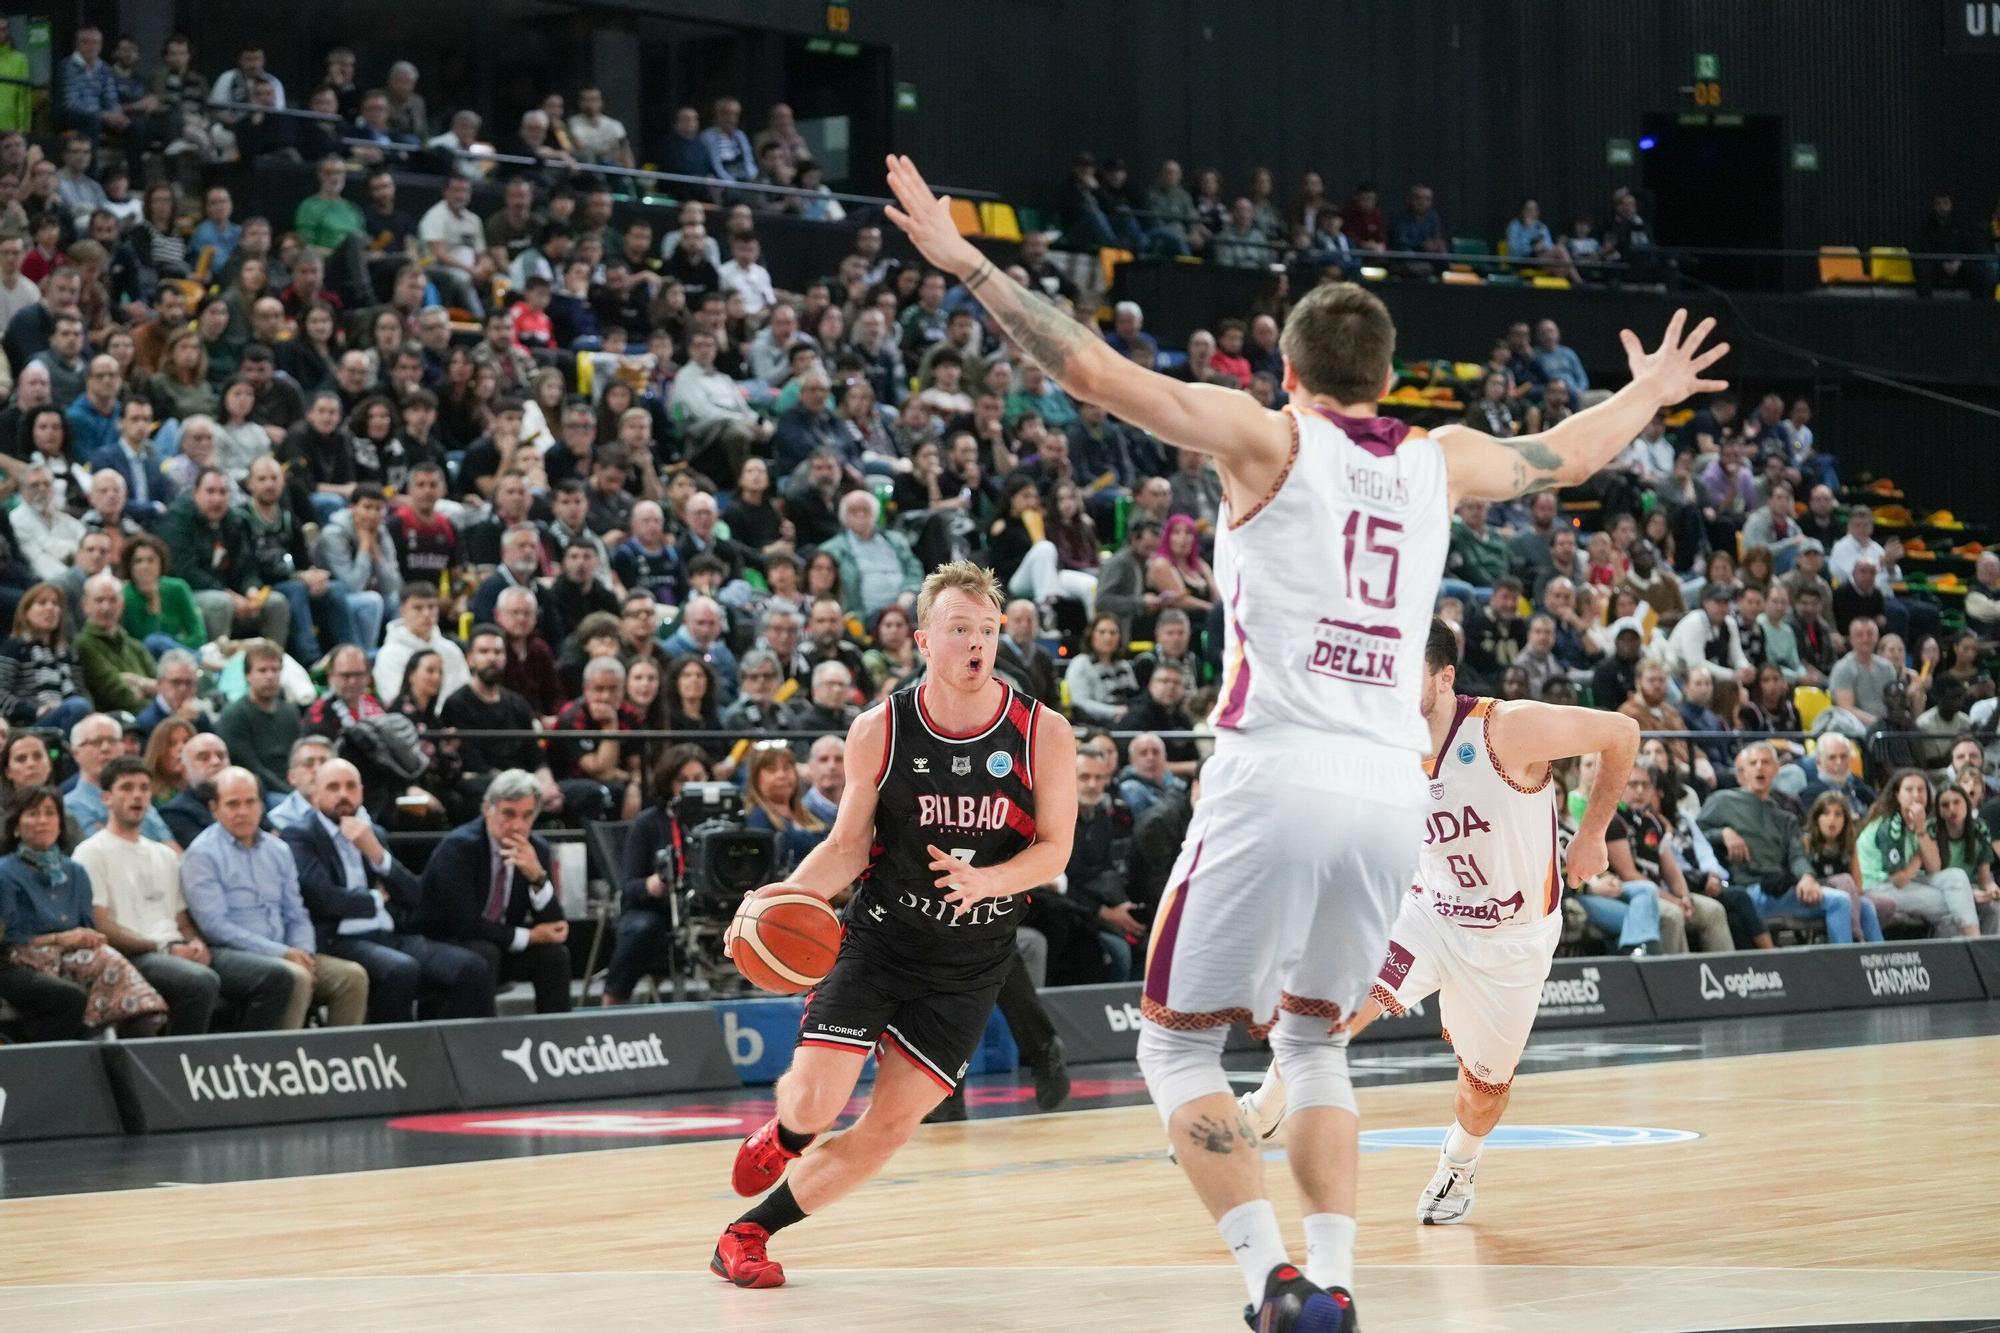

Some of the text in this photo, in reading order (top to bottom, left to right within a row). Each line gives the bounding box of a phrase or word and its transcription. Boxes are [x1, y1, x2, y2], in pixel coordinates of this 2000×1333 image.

[1342, 510, 1404, 609] 15
[1313, 640, 1395, 680] DELIN
[918, 793, 1010, 831] BILBAO
[1447, 853, 1488, 888] 61
[1866, 965, 1931, 996] LANDAKO
[817, 1023, 864, 1037] EL CORREO
[180, 1043, 407, 1102] kutxabank
[538, 1032, 669, 1078] Occident
